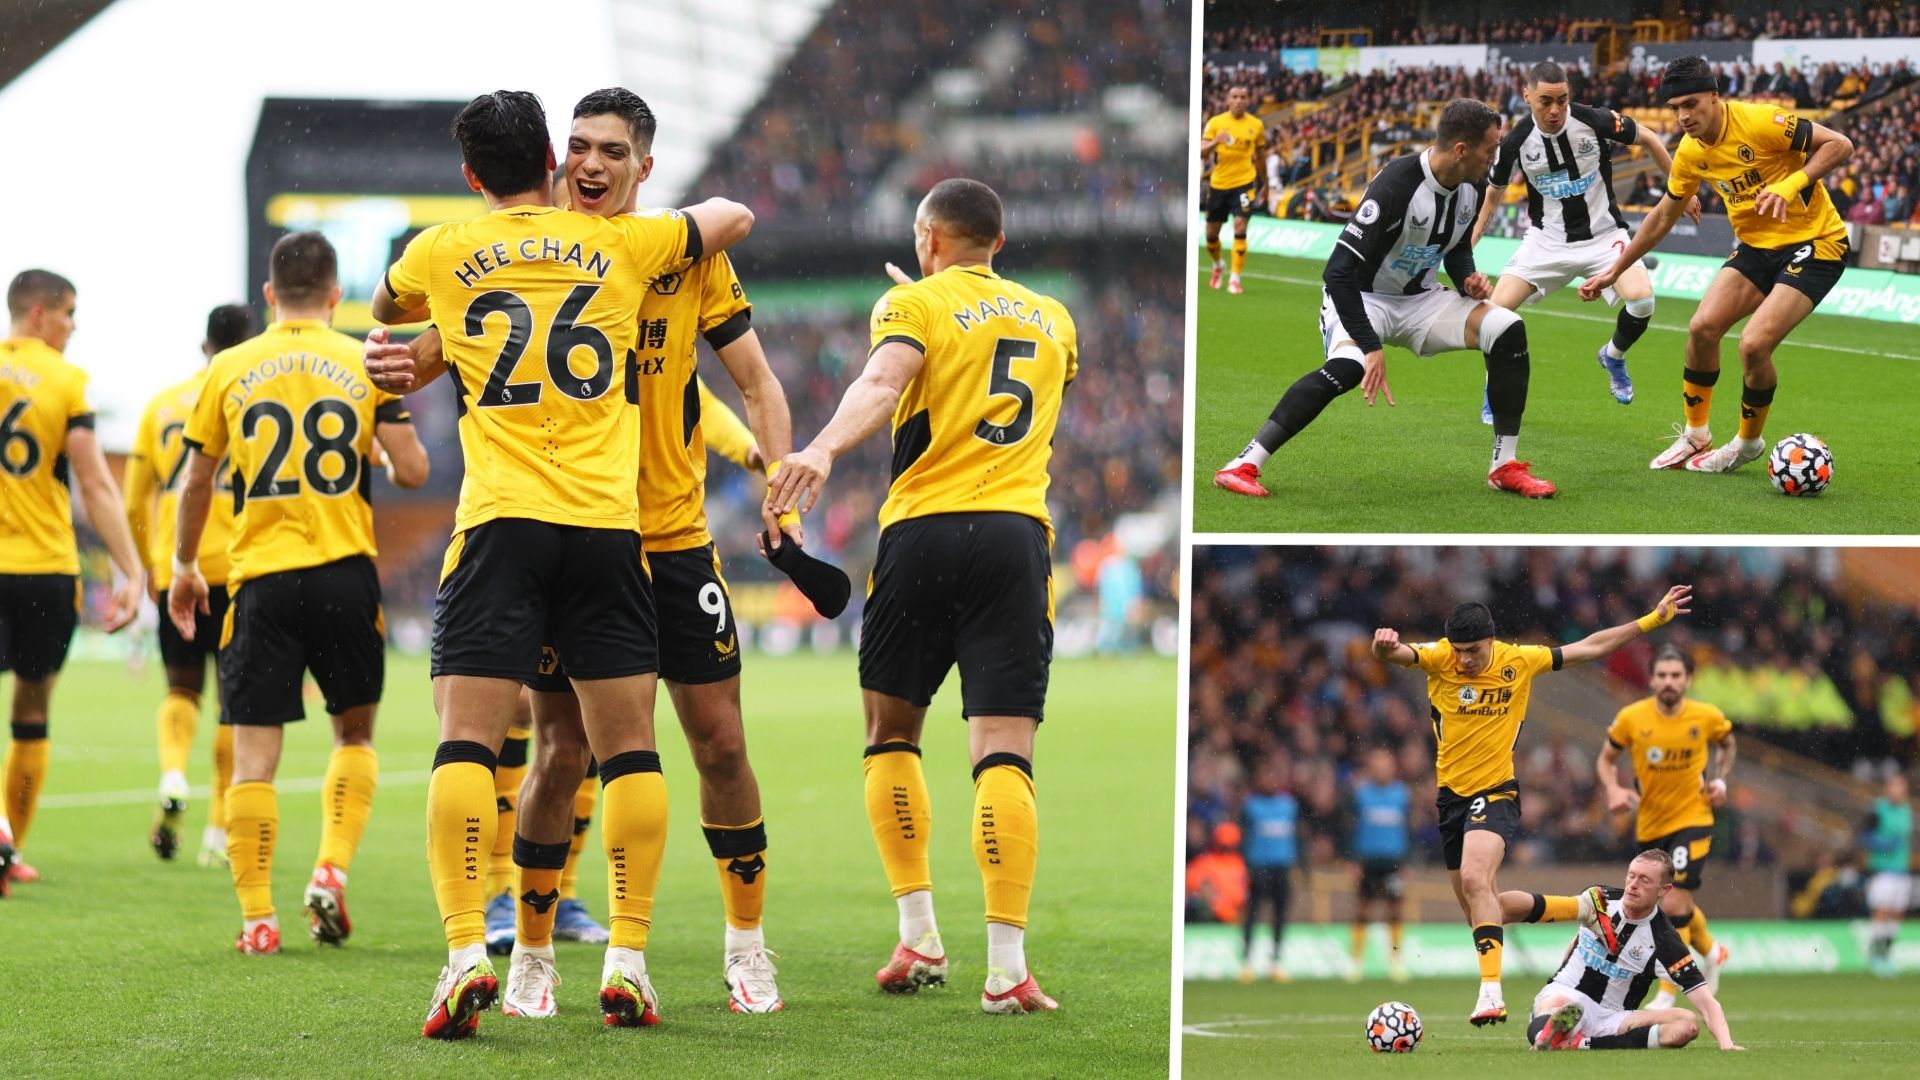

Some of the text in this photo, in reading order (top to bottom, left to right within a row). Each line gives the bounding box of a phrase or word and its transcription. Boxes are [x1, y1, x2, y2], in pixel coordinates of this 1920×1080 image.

[455, 237, 612, 288] HEE CHAN
[1792, 245, 1812, 263] 9
[464, 284, 614, 408] 26
[954, 297, 1056, 340] MARÇAL
[230, 352, 369, 410] J.MOUTINHO
[973, 337, 1037, 447] 5
[1320, 368, 1343, 392] NUFC
[0, 398, 42, 478] 6
[241, 398, 360, 499] 28
[698, 582, 726, 634] 9
[892, 784, 916, 840] CASTORE
[1470, 796, 1486, 815] 9
[465, 816, 481, 880] CASTORE
[981, 804, 1001, 864] CASTORE
[1672, 845, 1689, 870] 8
[615, 846, 626, 900] CASTORE
